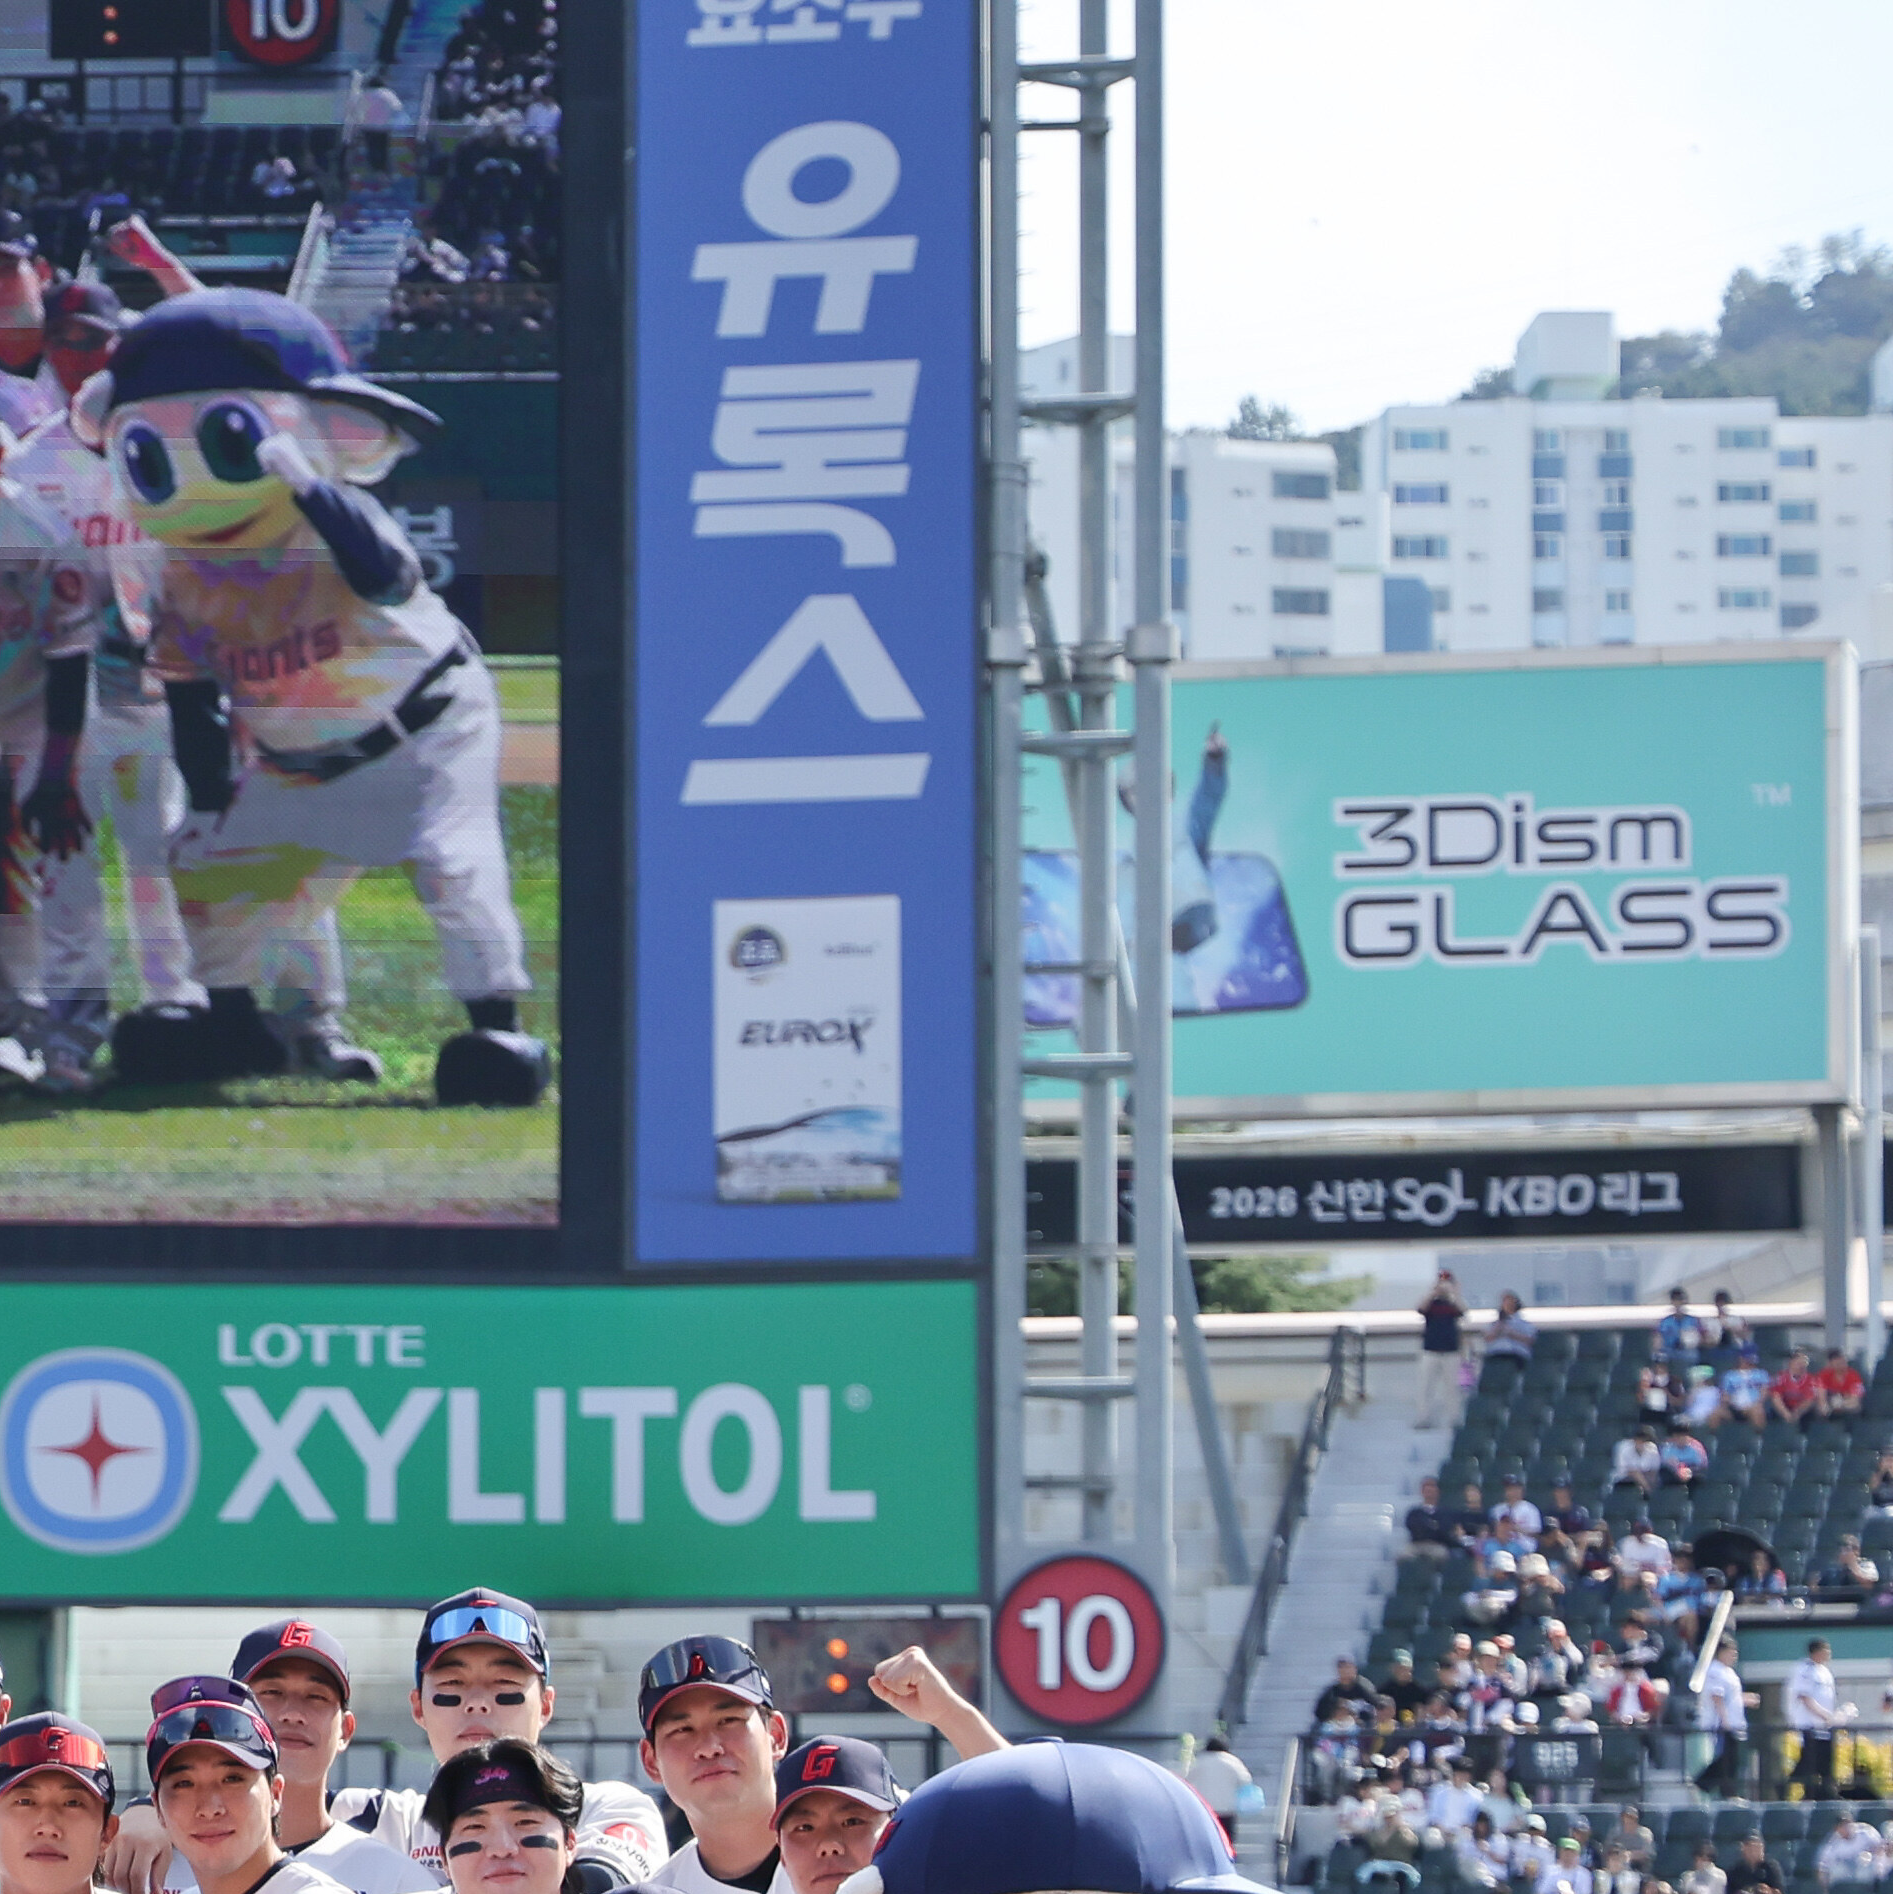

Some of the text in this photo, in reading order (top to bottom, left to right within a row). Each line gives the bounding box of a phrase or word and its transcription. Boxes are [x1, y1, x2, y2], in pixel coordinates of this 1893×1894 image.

[679, 120, 932, 806] 유록스
[1339, 800, 1688, 876] 3Dism
[1341, 880, 1787, 960] GLASS
[739, 1017, 875, 1054] EUROX
[1211, 1187, 1296, 1218] 2026
[1307, 1178, 1384, 1223] 신한
[219, 1323, 425, 1368] LOTTE
[217, 1384, 878, 1527] XYLITOL
[1018, 1594, 1136, 1692] 10
